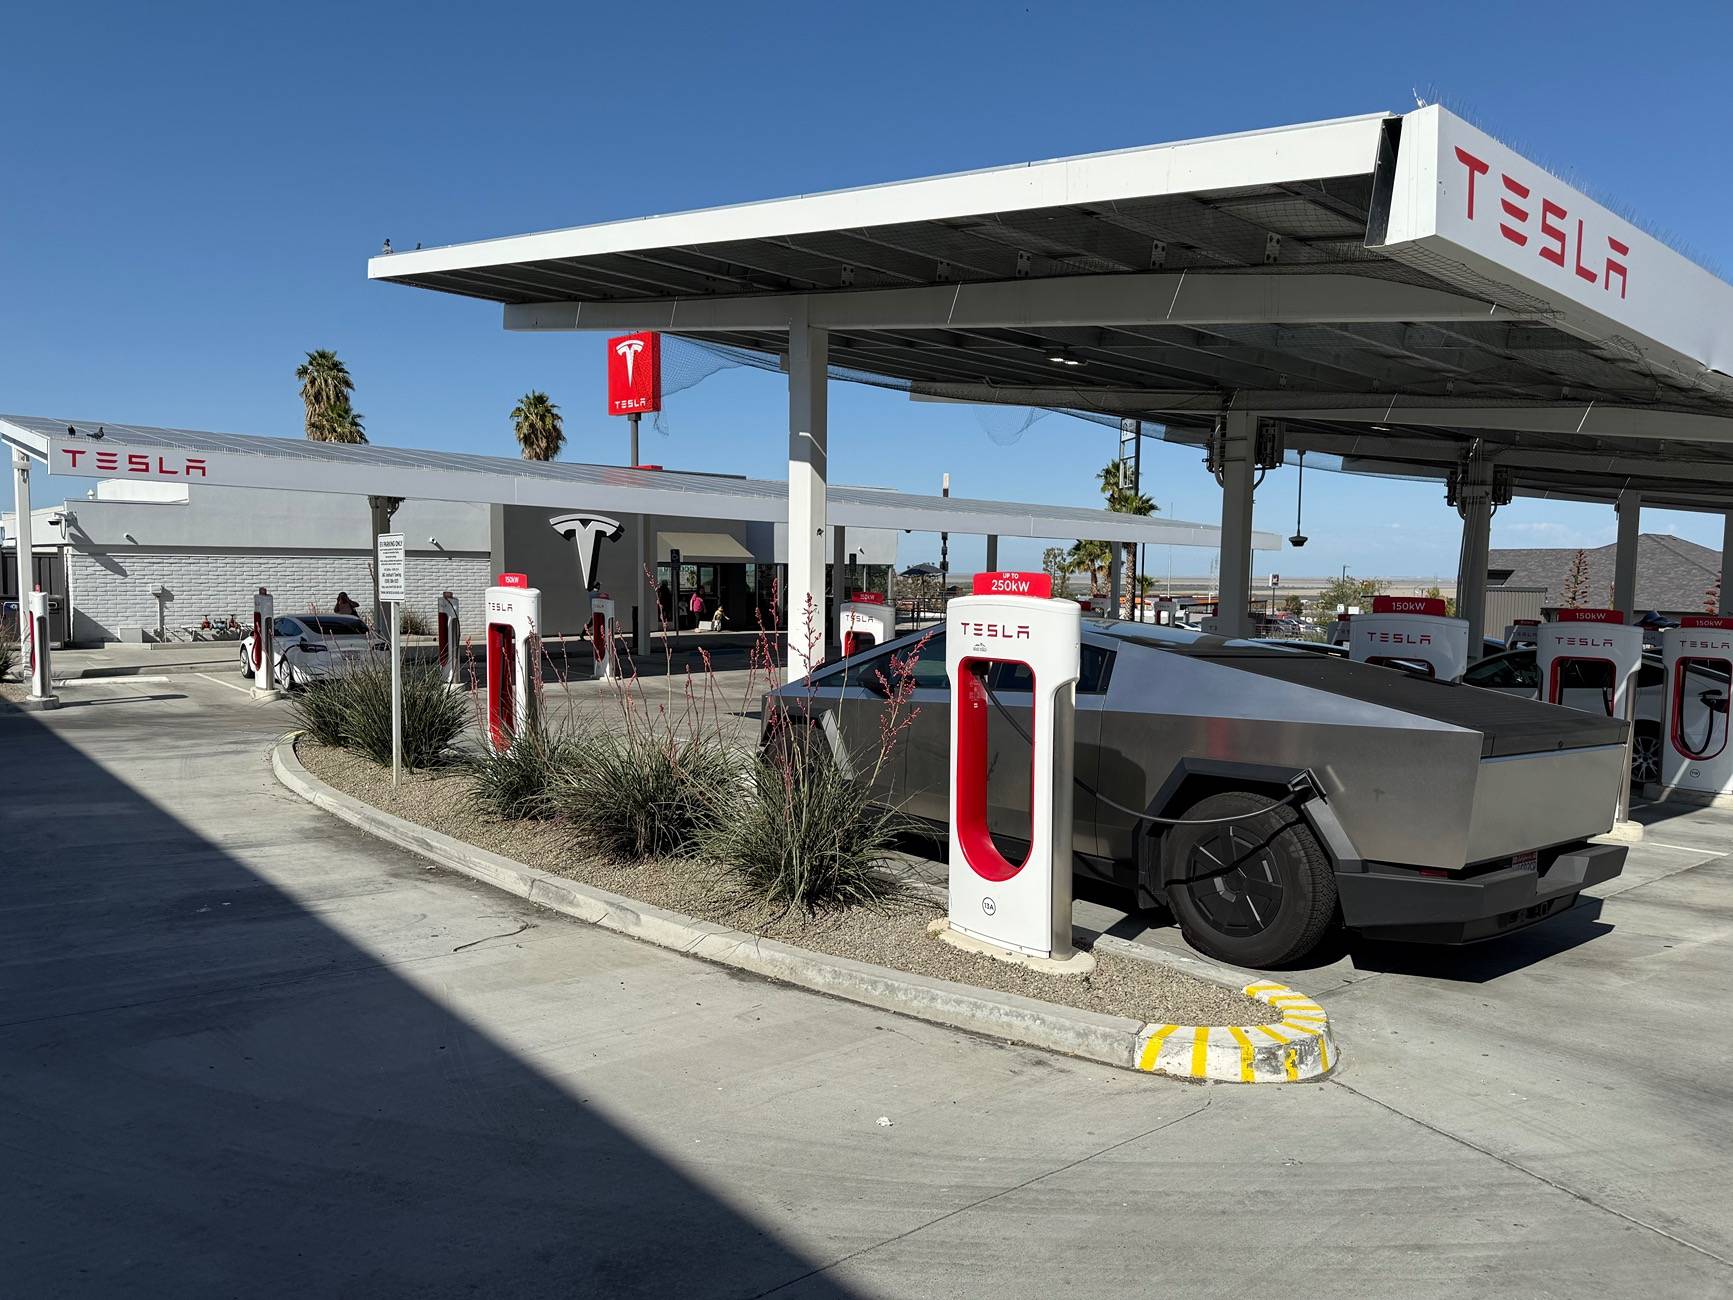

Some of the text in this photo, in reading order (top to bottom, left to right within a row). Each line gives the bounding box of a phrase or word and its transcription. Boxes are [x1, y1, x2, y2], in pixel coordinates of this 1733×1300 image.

[1454, 145, 1630, 300] TESLA
[614, 398, 647, 409] TESLA
[61, 449, 206, 477] TESLA
[991, 579, 1030, 592] 250kW
[488, 602, 513, 611] TESLA
[1391, 602, 1426, 611] 150kW
[1575, 612, 1606, 620] 150kW
[961, 622, 1030, 639] TESLA
[1367, 631, 1431, 645] TESLA
[1555, 636, 1613, 647] TESLA
[1680, 640, 1730, 649] TESLA
